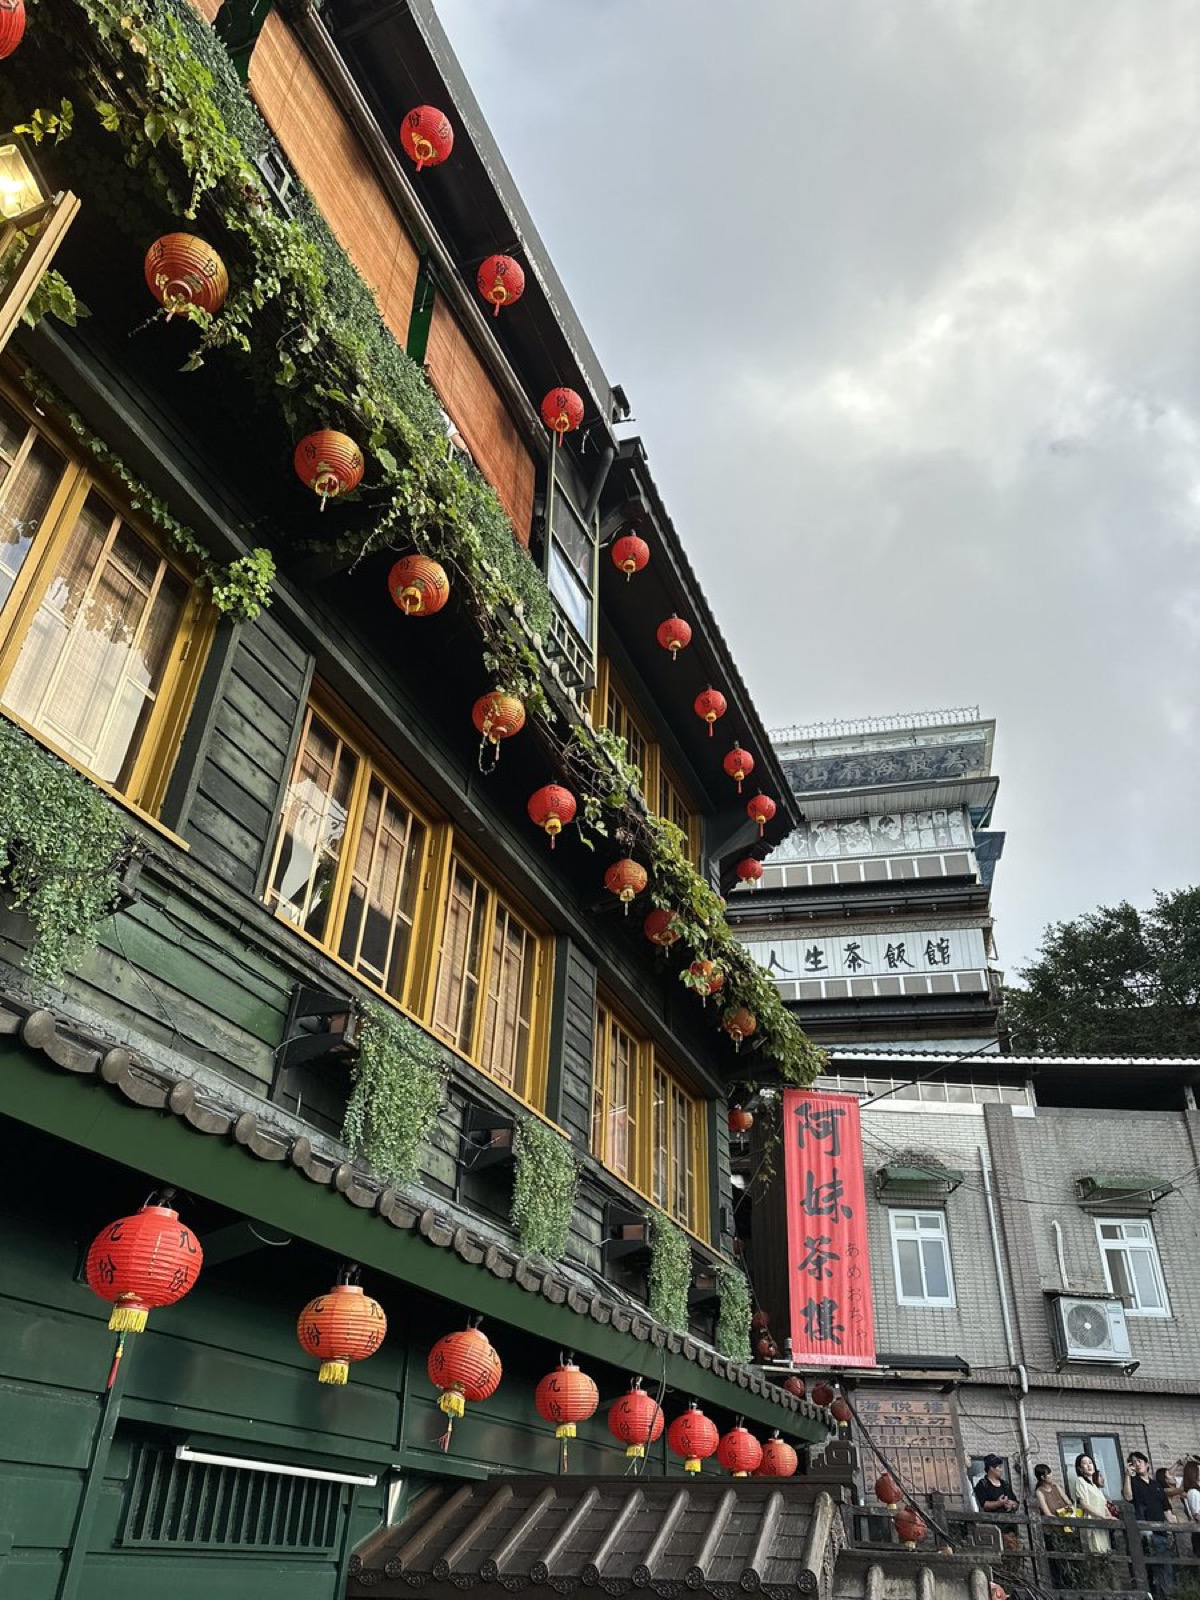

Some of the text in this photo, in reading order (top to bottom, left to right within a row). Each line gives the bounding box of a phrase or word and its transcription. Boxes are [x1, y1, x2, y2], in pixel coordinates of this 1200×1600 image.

[767, 937, 951, 973] 人生茶飯館
[793, 1102, 853, 1346] 阿妹茶樓
[98, 1221, 124, 1285] 九份
[166, 1229, 197, 1293] 九份
[305, 1296, 326, 1347] 九份
[549, 1378, 562, 1417] 九份
[619, 1400, 632, 1437] 九份
[681, 1418, 692, 1449] 九份
